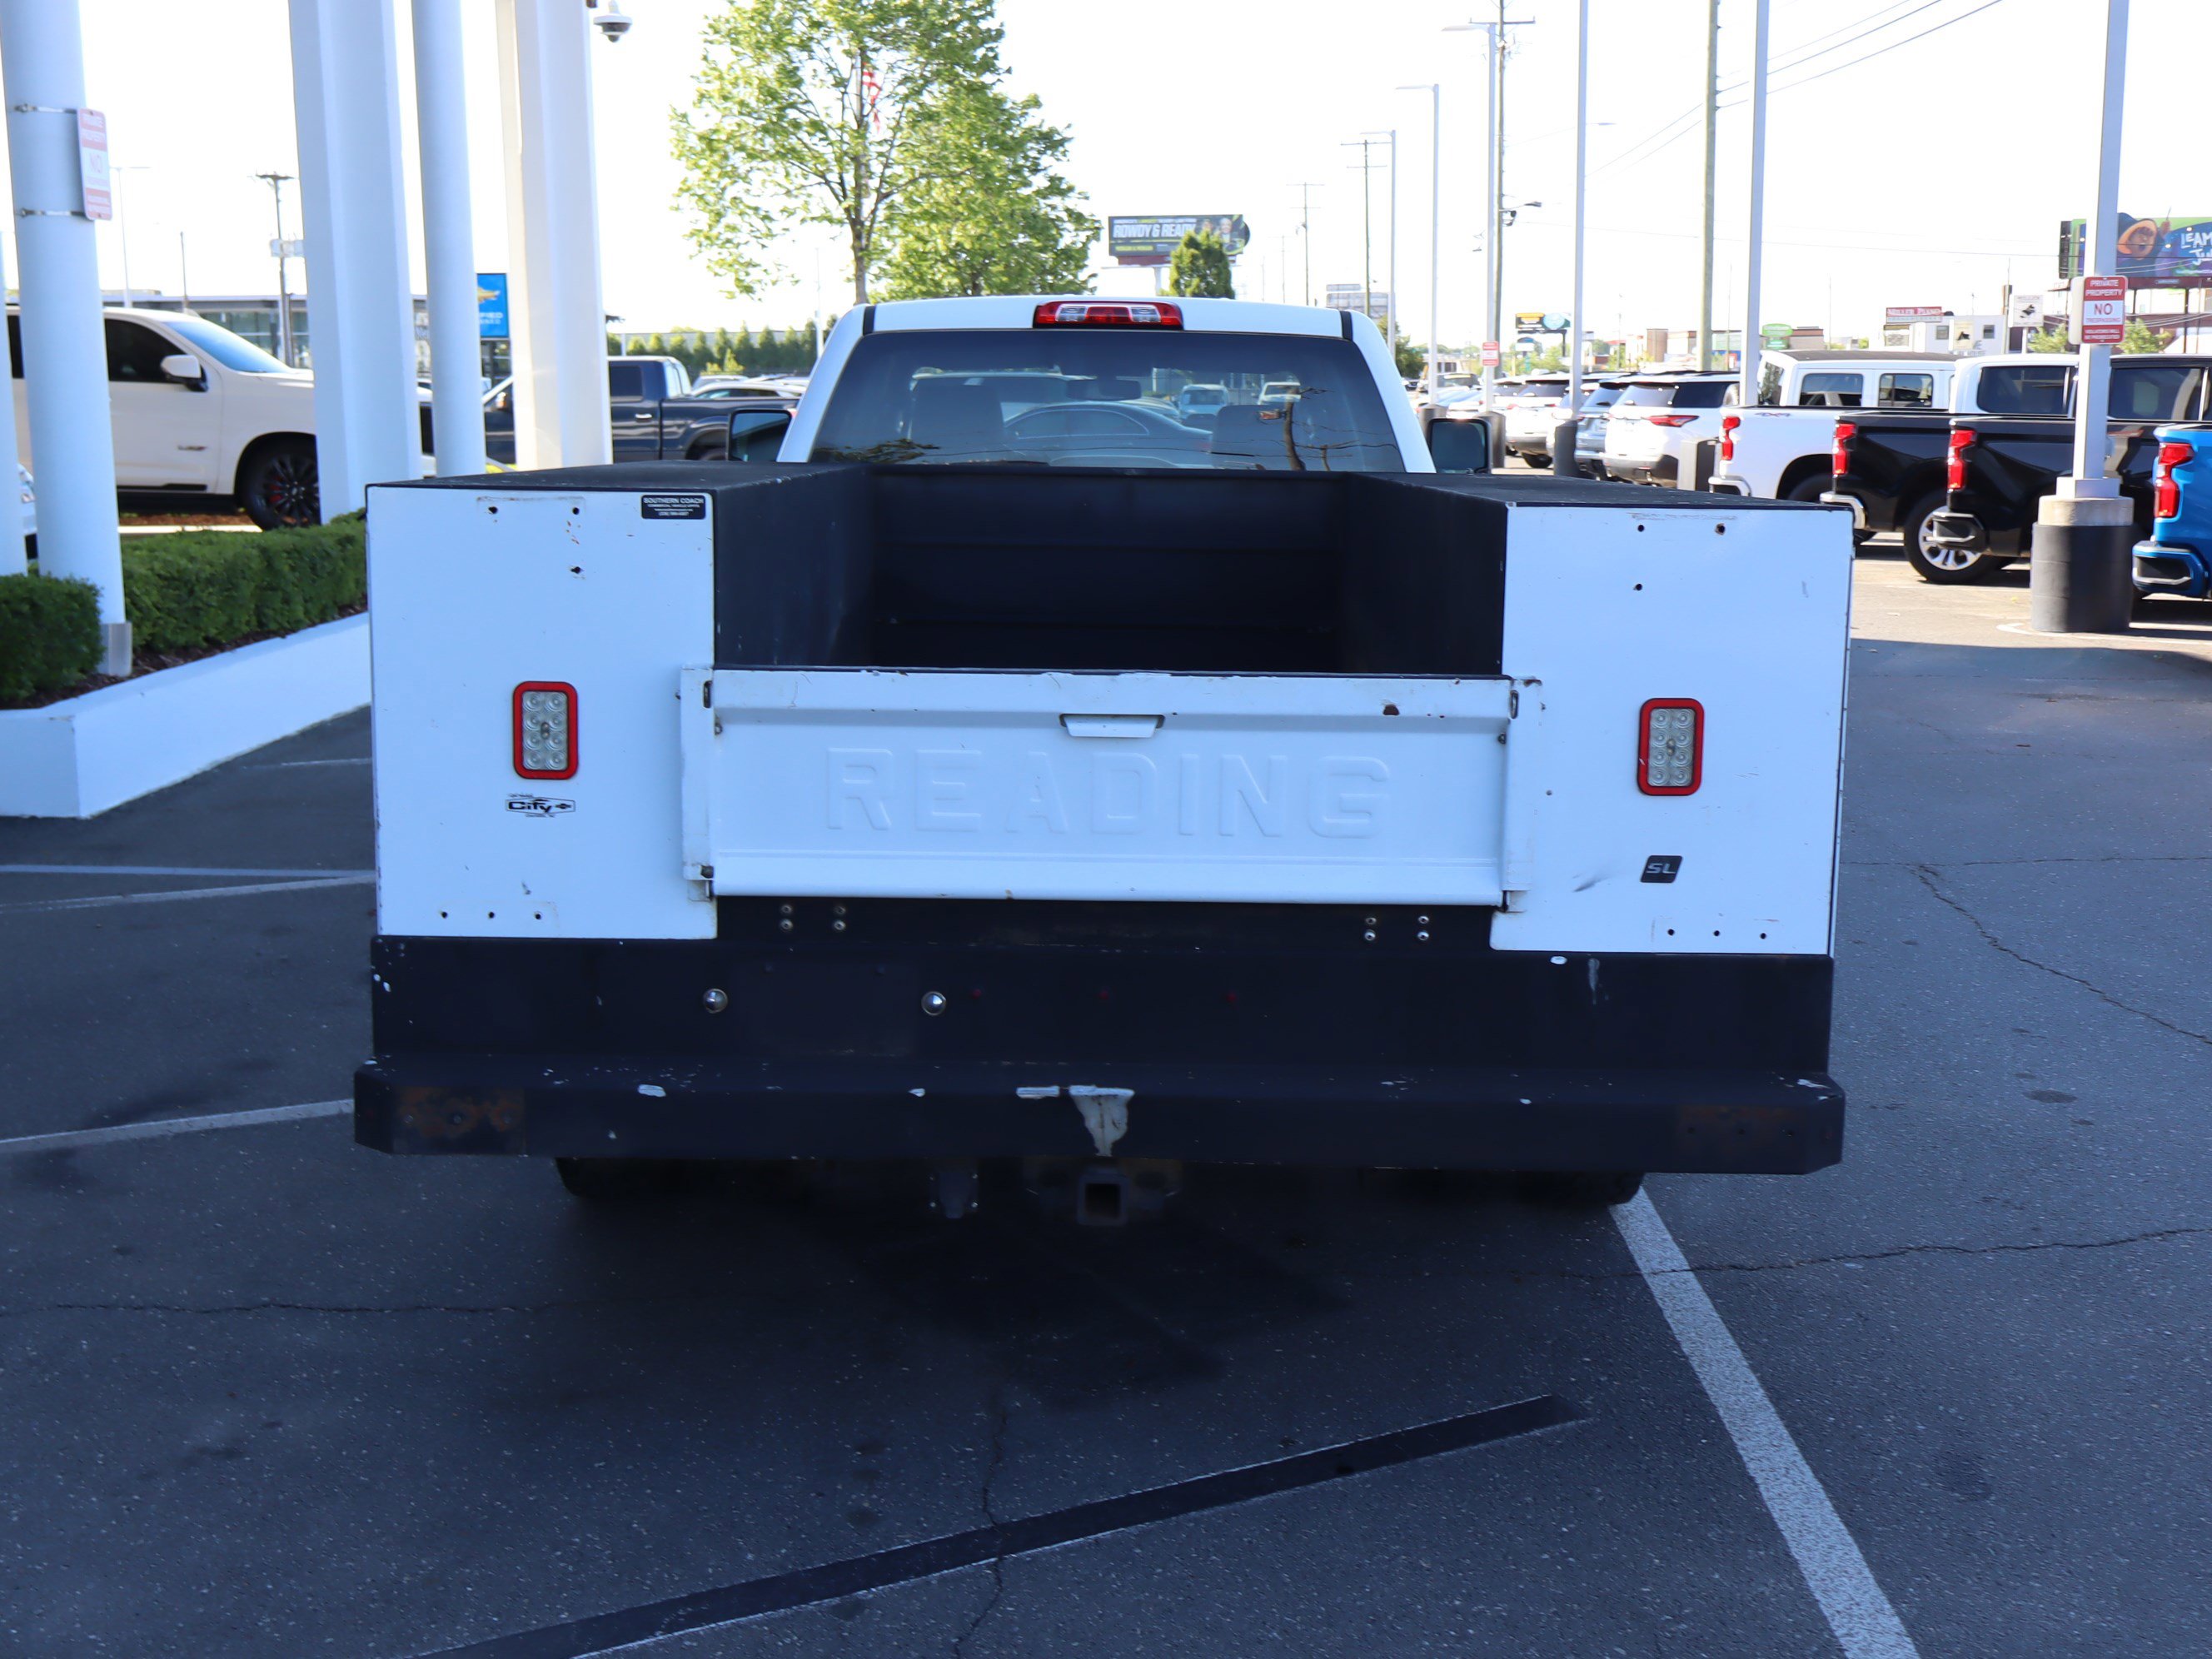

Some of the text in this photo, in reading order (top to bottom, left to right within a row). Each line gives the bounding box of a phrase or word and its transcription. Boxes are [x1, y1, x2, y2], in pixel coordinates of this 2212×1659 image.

[1113, 224, 1152, 237] ROWDY
[2094, 303, 2113, 315] NO
[827, 747, 1390, 839] READING
[1646, 863, 1676, 874] SL
